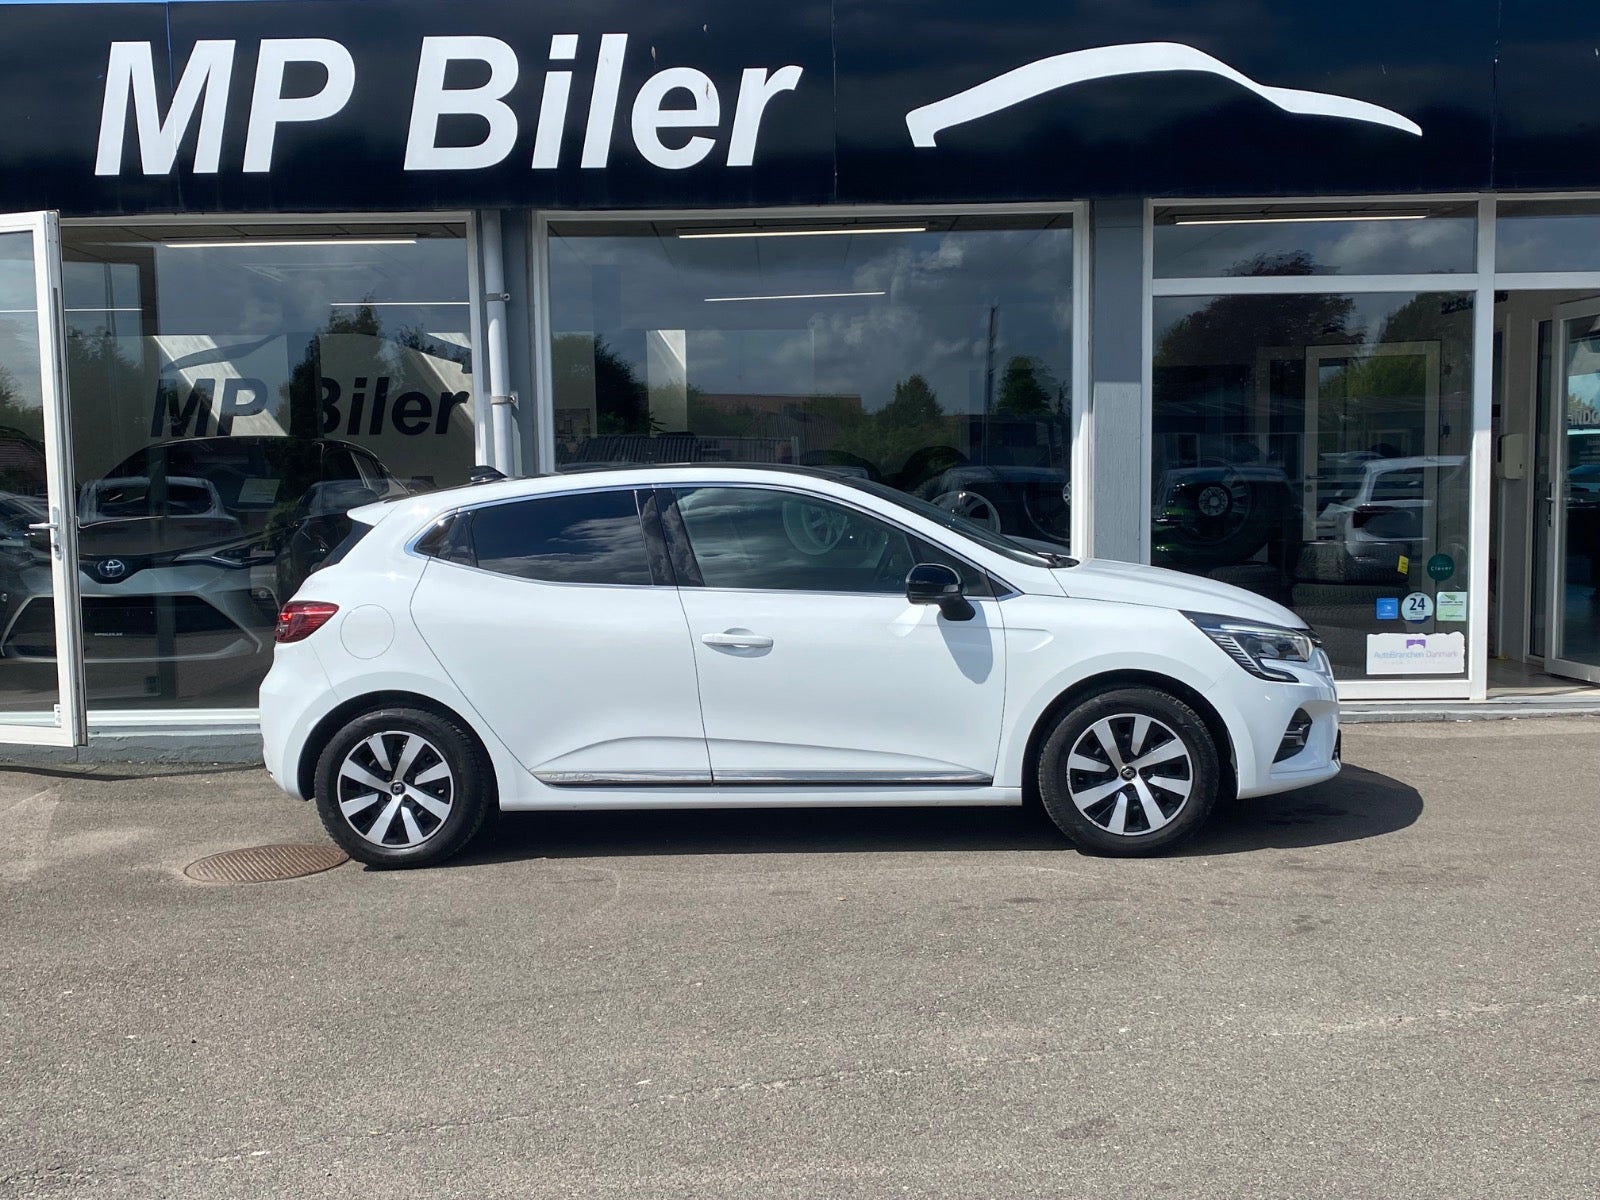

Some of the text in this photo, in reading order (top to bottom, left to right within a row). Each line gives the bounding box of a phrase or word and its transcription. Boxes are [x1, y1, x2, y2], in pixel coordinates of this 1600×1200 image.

[95, 33, 804, 176] MP Biler
[150, 378, 268, 437] MP
[1409, 597, 1426, 611] 24
